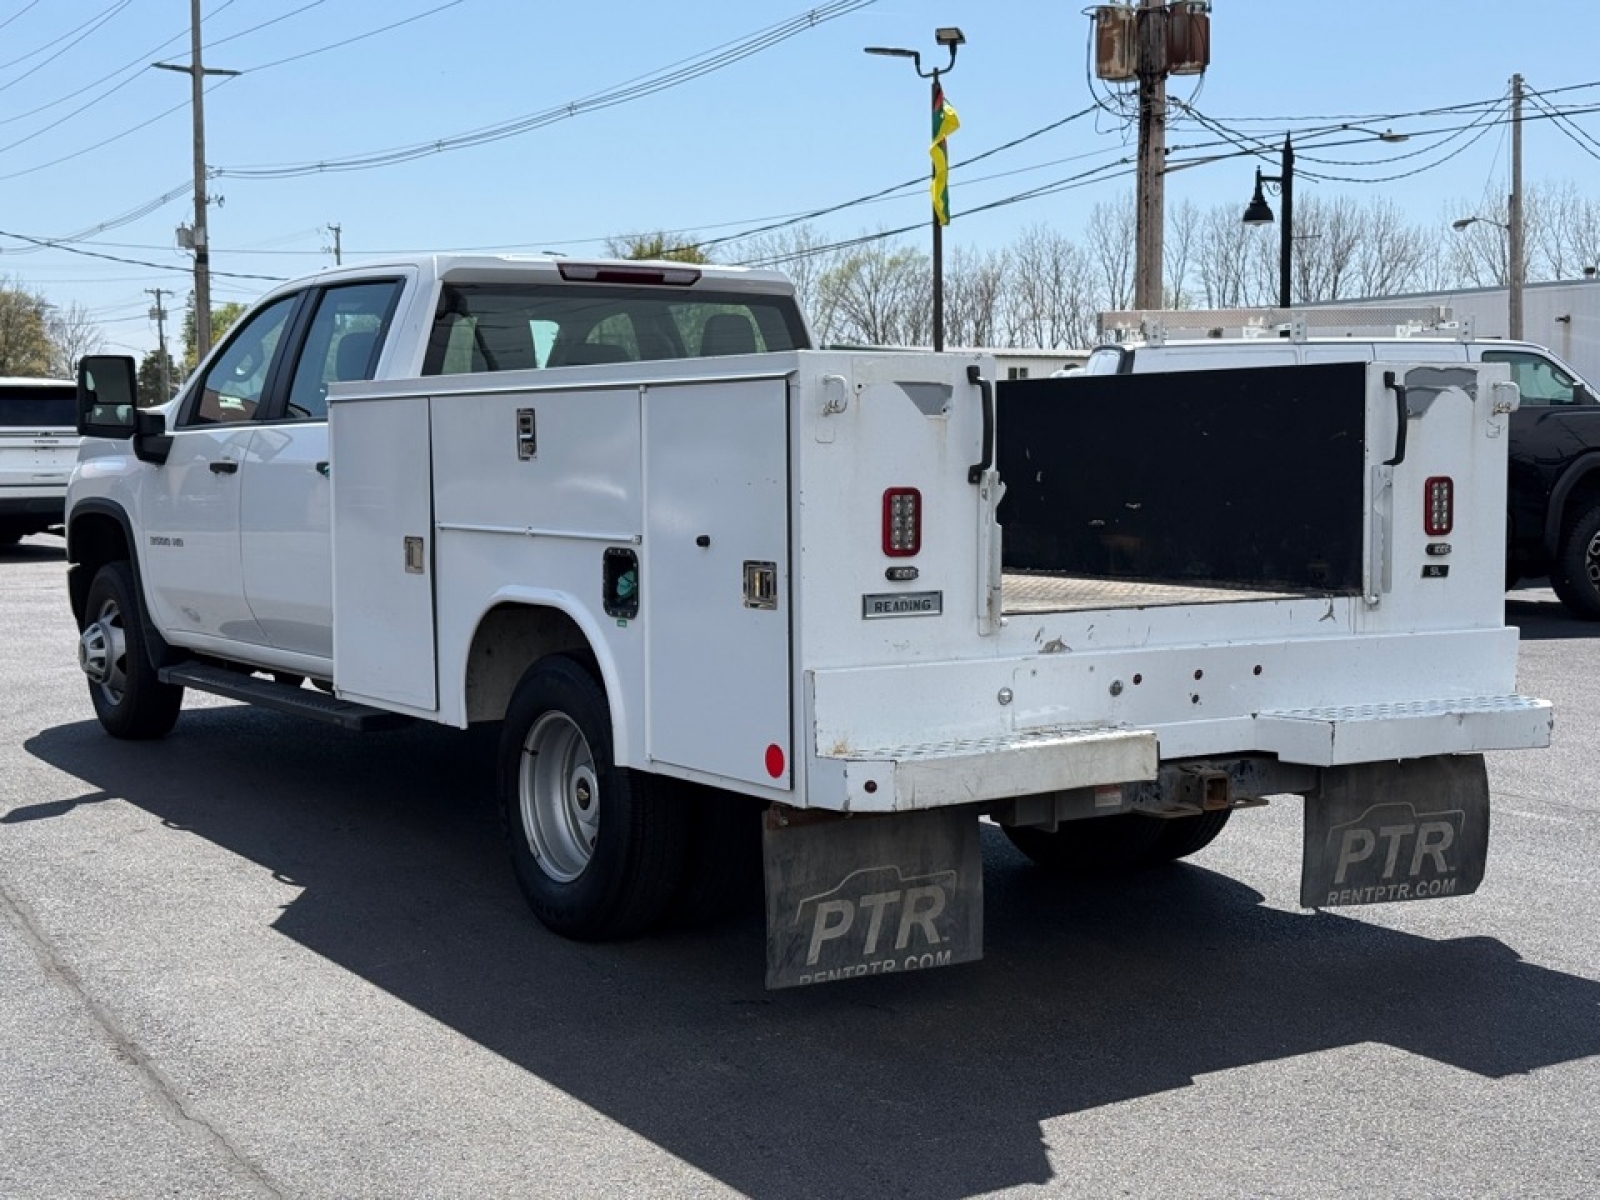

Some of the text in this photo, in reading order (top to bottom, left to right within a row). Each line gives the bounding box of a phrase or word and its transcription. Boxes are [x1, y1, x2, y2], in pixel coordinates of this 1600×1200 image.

[874, 599, 932, 613] READING
[1334, 821, 1455, 884] PTR
[1327, 878, 1457, 906] RENTPTR.COM
[806, 885, 946, 966] PTR
